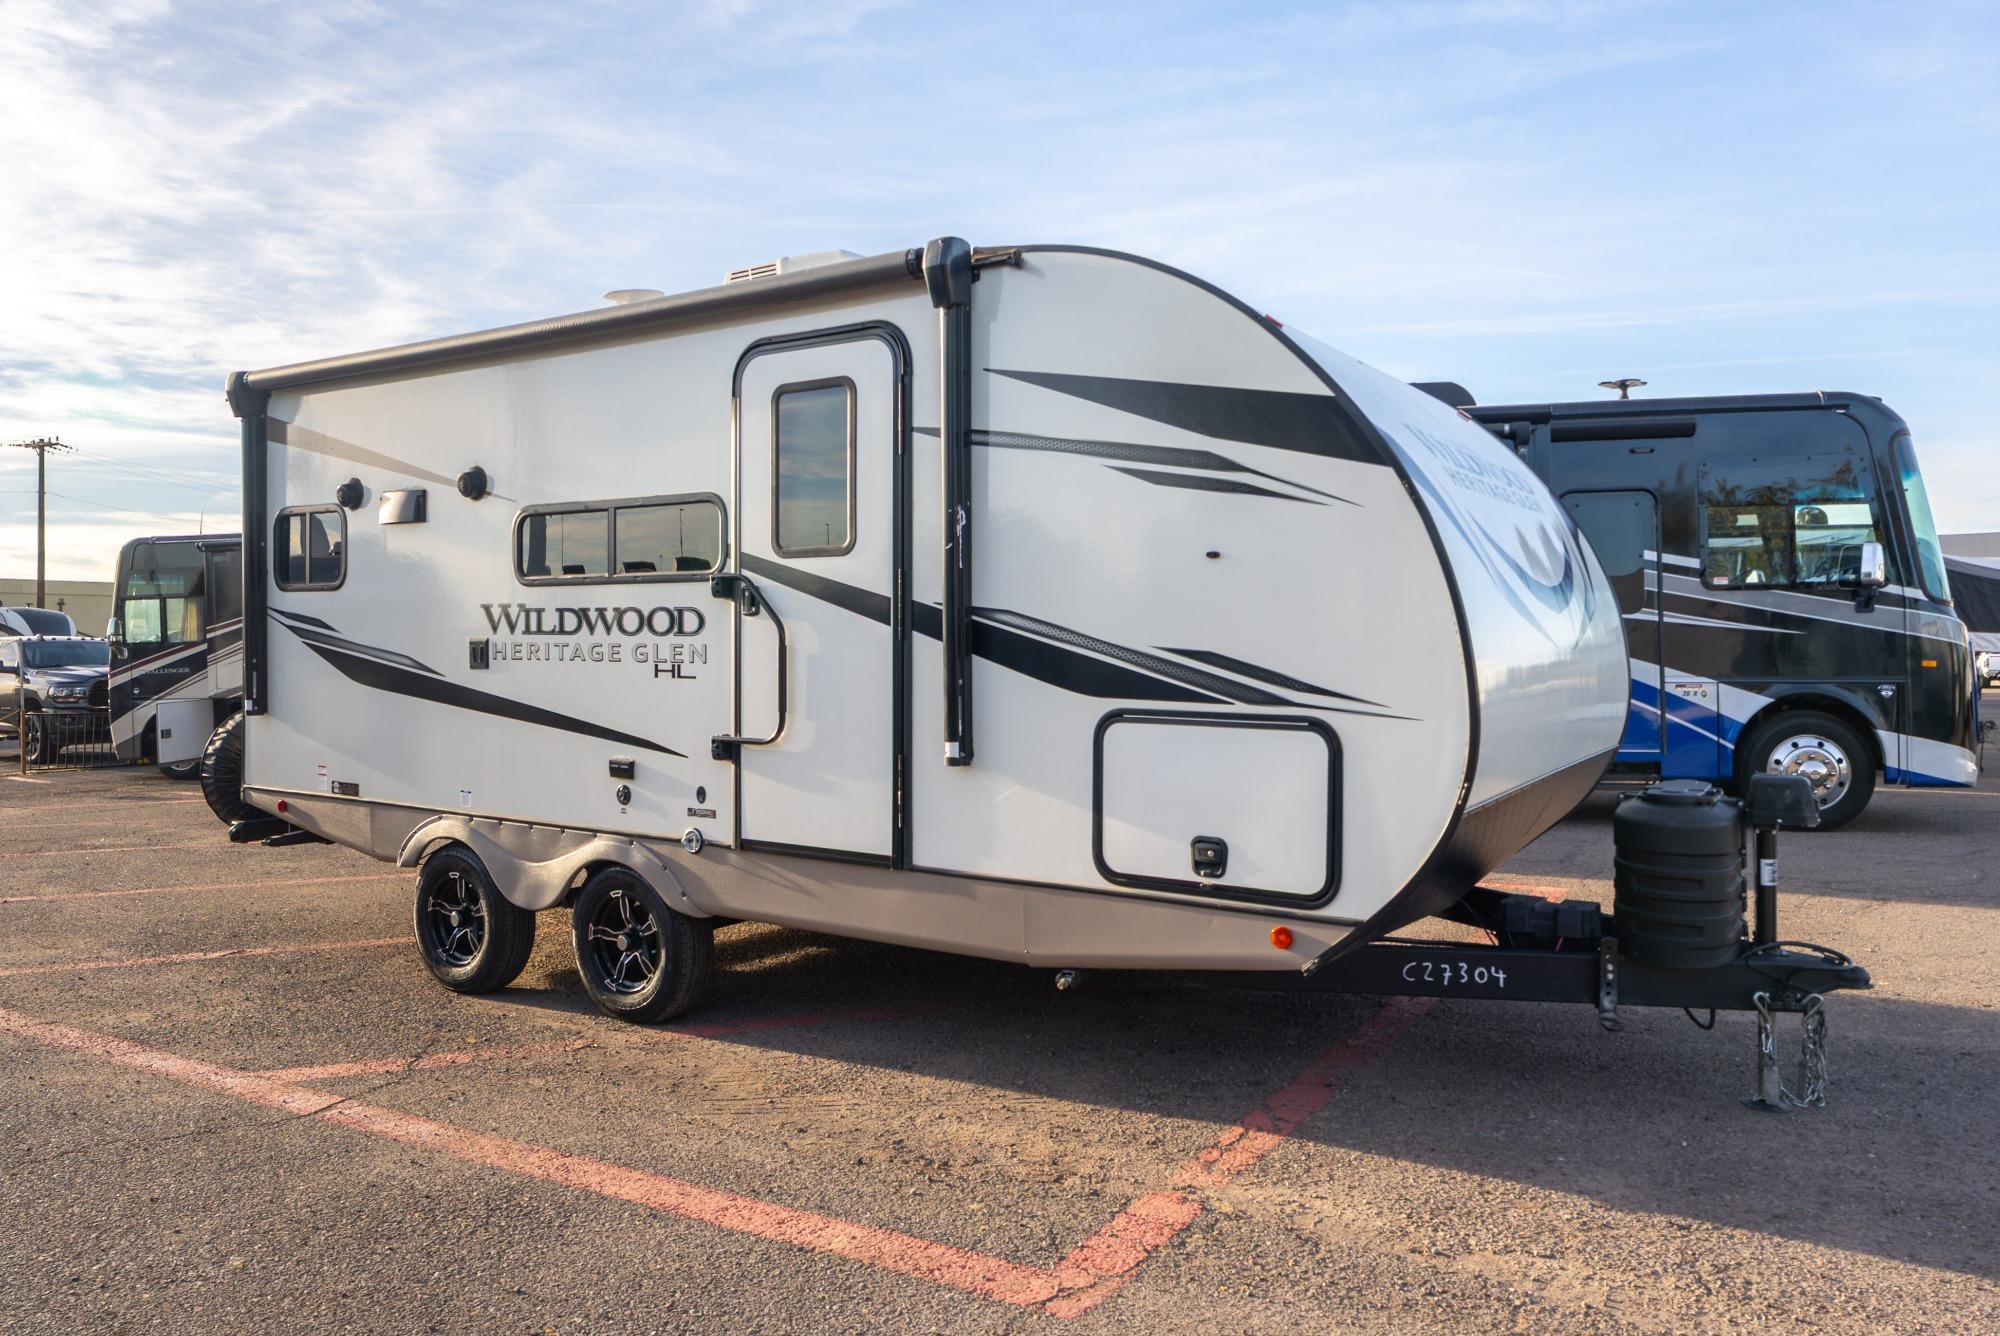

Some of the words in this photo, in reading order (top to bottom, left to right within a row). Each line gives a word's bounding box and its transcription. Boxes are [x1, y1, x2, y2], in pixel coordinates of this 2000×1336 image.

[480, 603, 706, 637] WILDWOOD
[492, 641, 622, 663] HERITAGE
[631, 643, 708, 664] GLEN
[654, 664, 697, 680] HL
[1402, 962, 1507, 987] C27304
